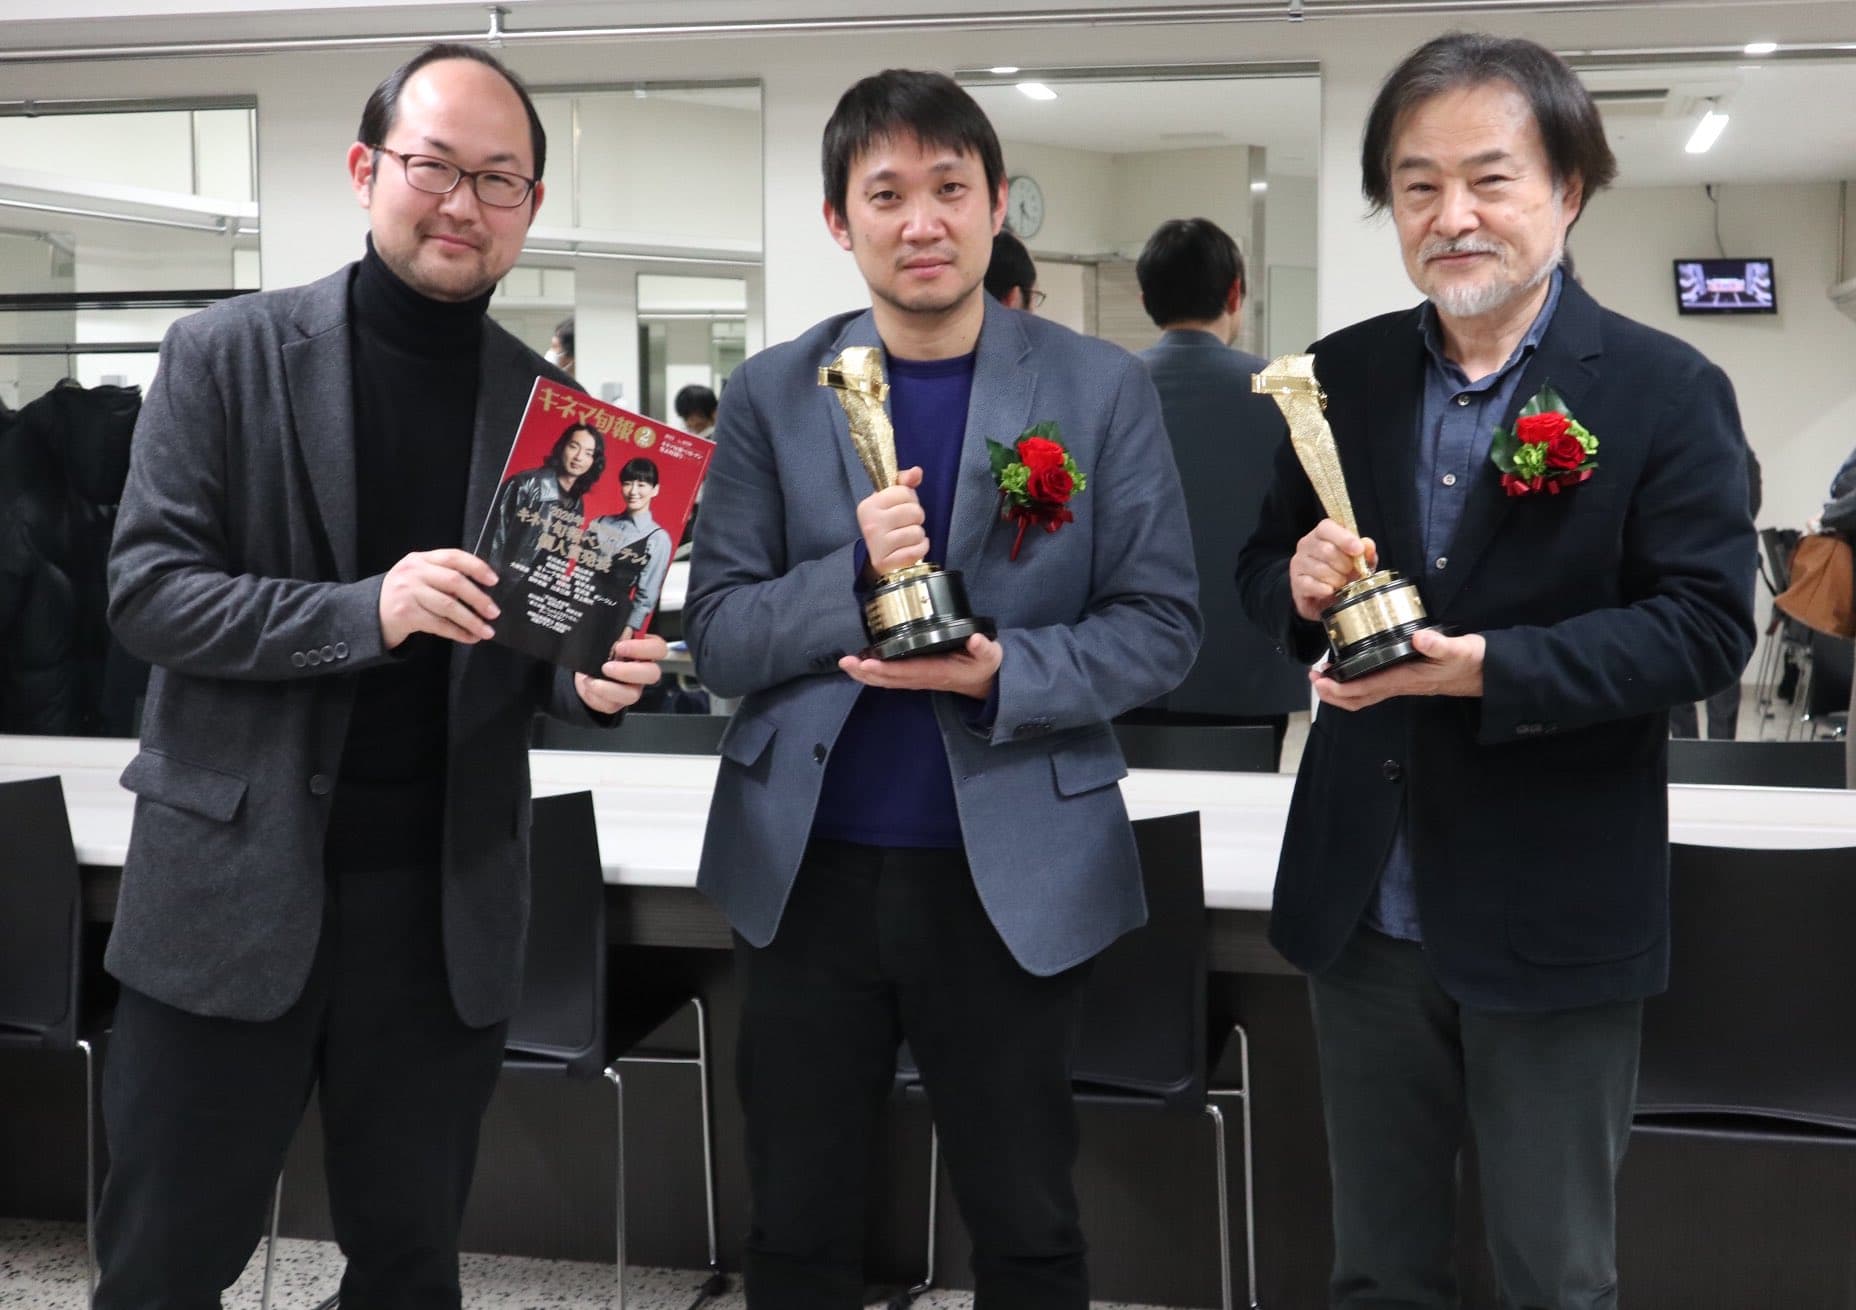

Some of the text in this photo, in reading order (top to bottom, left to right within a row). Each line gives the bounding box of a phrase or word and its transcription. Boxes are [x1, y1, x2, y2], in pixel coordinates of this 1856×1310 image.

[538, 387, 635, 443] キネマ旬報
